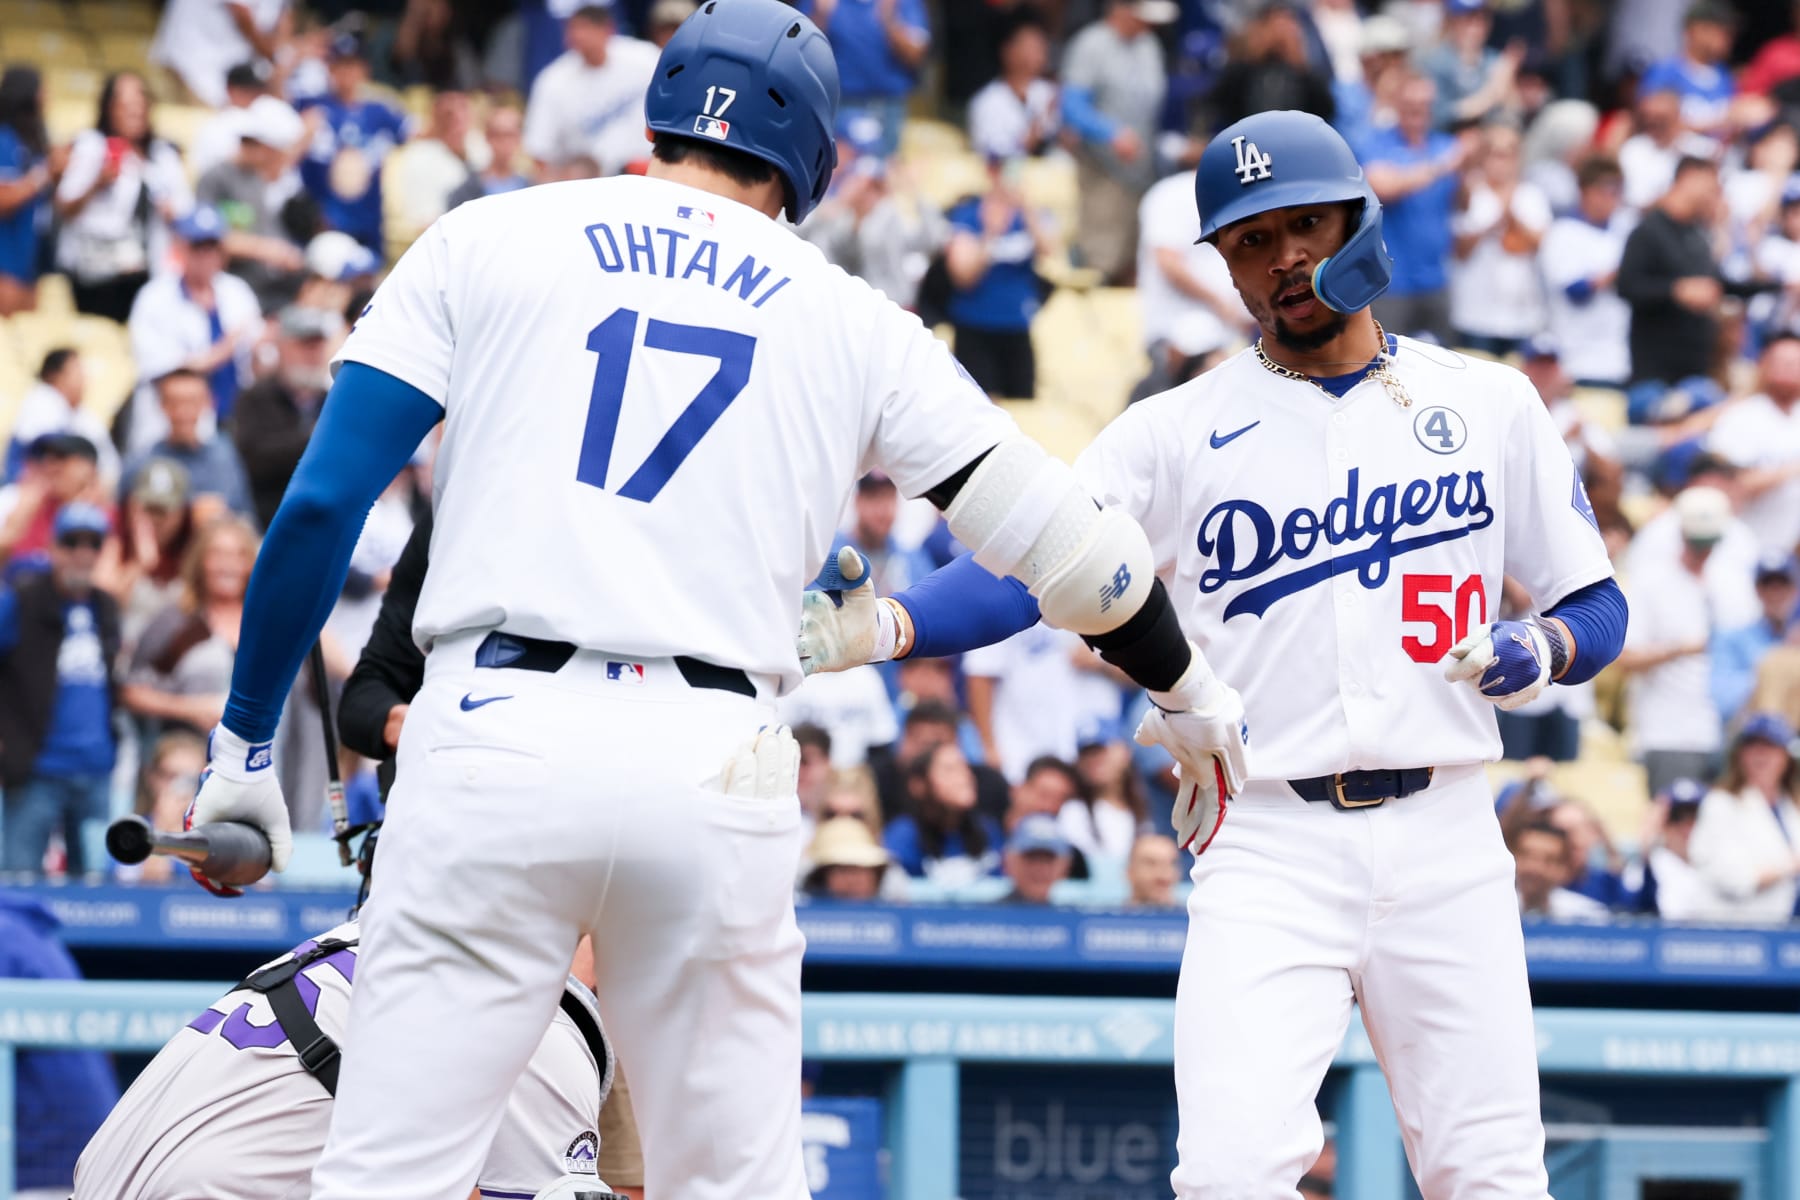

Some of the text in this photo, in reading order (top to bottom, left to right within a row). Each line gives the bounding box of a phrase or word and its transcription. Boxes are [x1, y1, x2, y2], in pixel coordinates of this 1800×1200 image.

[703, 86, 736, 117] 17
[1231, 136, 1271, 184] LA
[584, 222, 792, 308] OHTANI
[576, 307, 757, 503] 17
[1424, 411, 1454, 447] 4
[1197, 467, 1494, 594] Dodgers
[1402, 574, 1486, 663] 50
[817, 1020, 1097, 1056] BANK OF AMERICA
[994, 1098, 1159, 1183] blue
